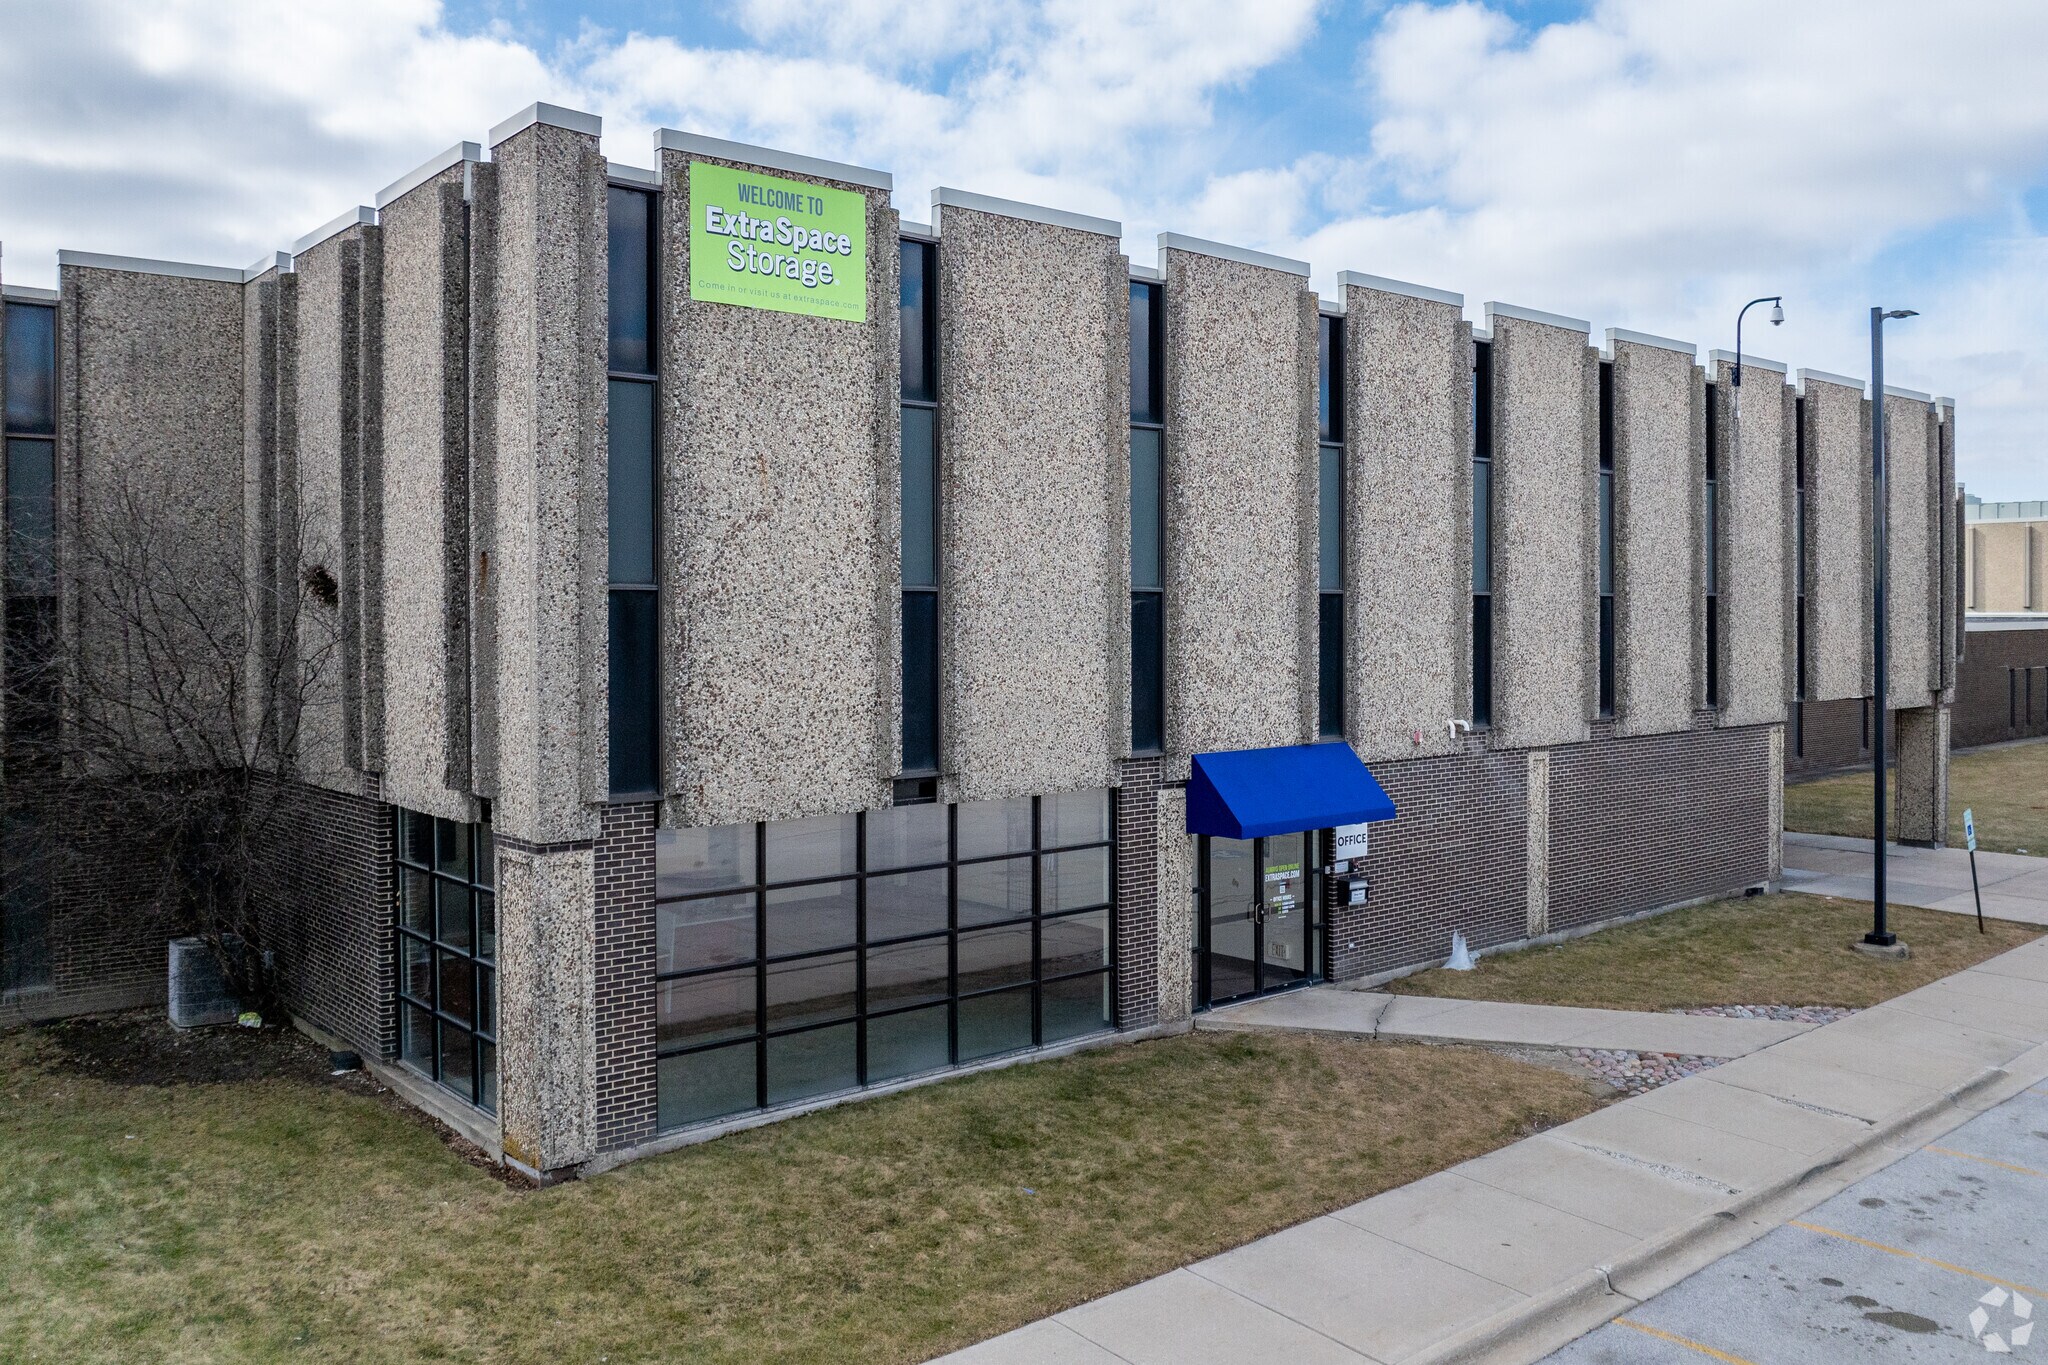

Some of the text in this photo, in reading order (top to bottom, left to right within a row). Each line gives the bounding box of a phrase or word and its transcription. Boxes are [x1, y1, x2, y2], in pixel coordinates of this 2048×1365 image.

[737, 183, 824, 217] WELCOME TO
[705, 204, 852, 256] ExtraSpace
[727, 240, 834, 288] Storage
[698, 280, 860, 310] Come in or visit us at extraspace.com
[1337, 833, 1367, 847] OFFICE
[1265, 870, 1300, 882] EXTRASPACE.COM
